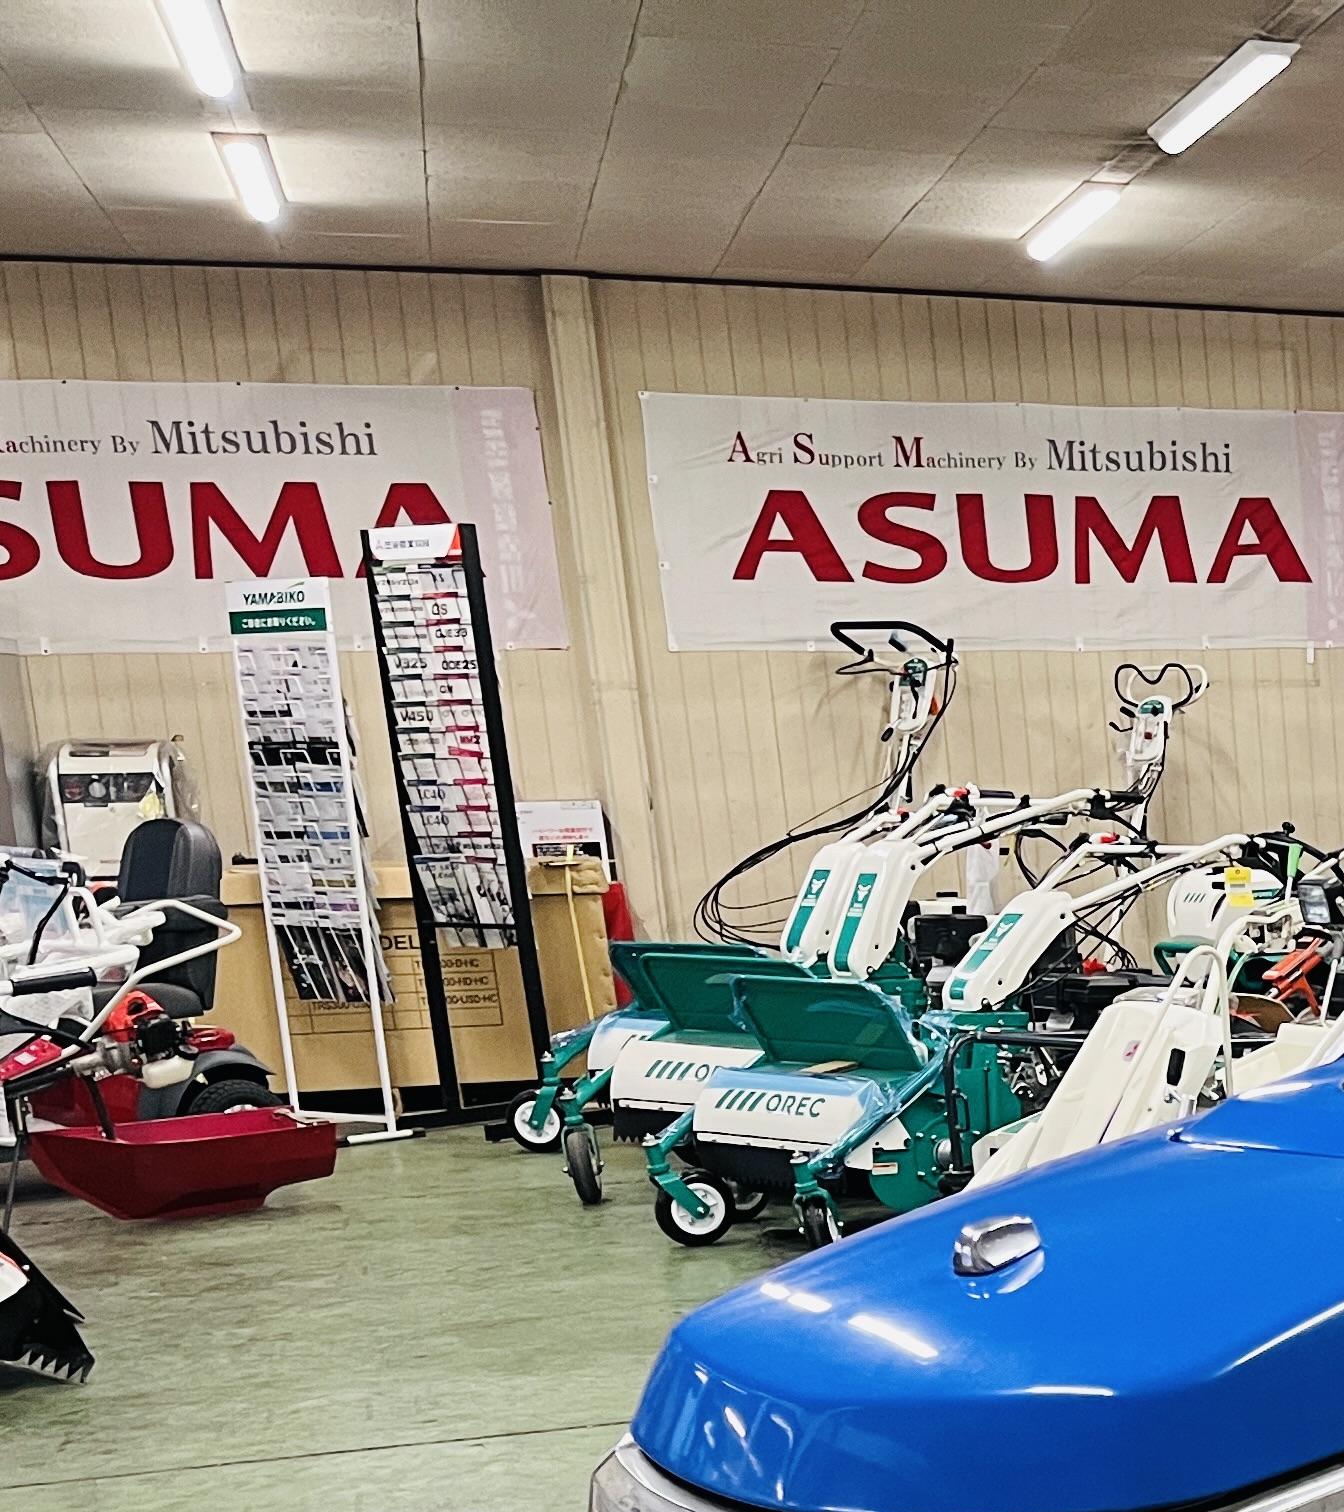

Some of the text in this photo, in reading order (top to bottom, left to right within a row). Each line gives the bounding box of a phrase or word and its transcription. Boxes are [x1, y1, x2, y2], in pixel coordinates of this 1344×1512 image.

[0, 420, 378, 457] achinery By Mitsubishi
[727, 430, 1232, 474] Agri Support Machinery By Mitsubishi
[732, 489, 1313, 584] ASUMA
[242, 590, 305, 605] YAMABIKO
[378, 934, 421, 950] DEL
[765, 1093, 826, 1118] OREC
